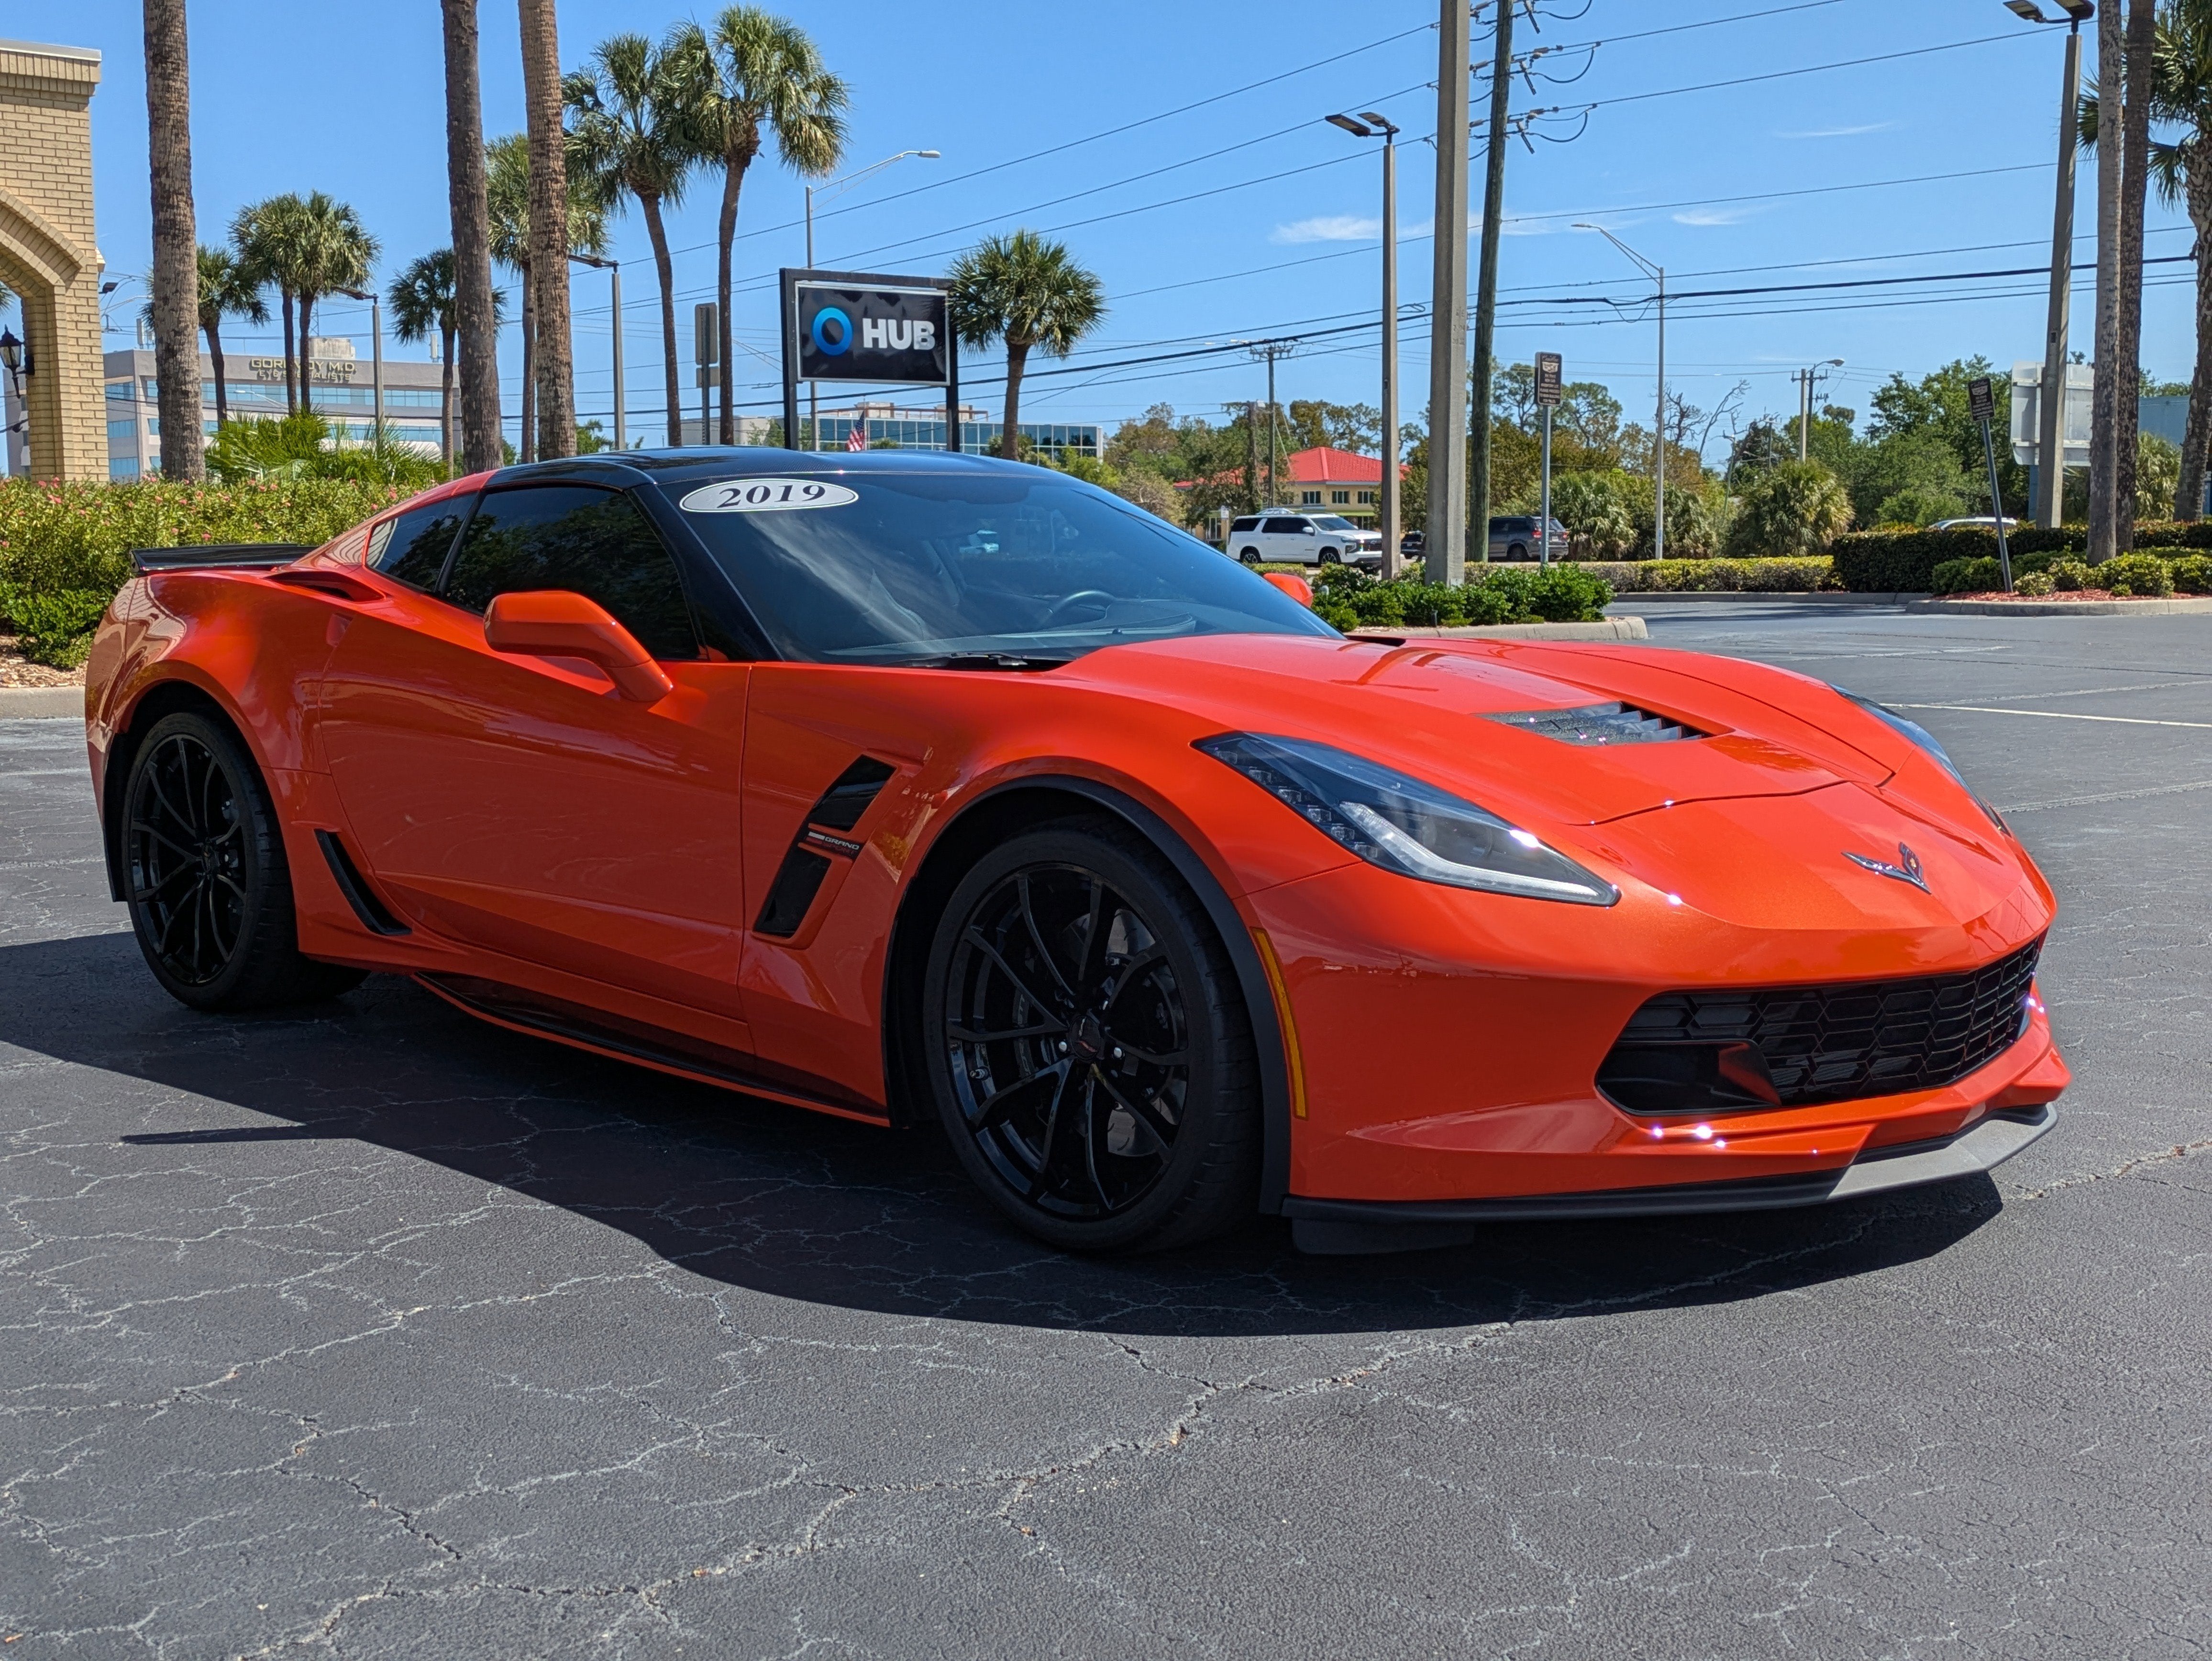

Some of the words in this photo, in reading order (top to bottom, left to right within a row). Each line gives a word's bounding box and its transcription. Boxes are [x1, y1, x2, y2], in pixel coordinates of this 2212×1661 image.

[863, 318, 935, 350] HUB
[283, 370, 351, 381] SEIALISTS
[717, 485, 826, 508] 2019
[825, 836, 860, 850] GRAND
